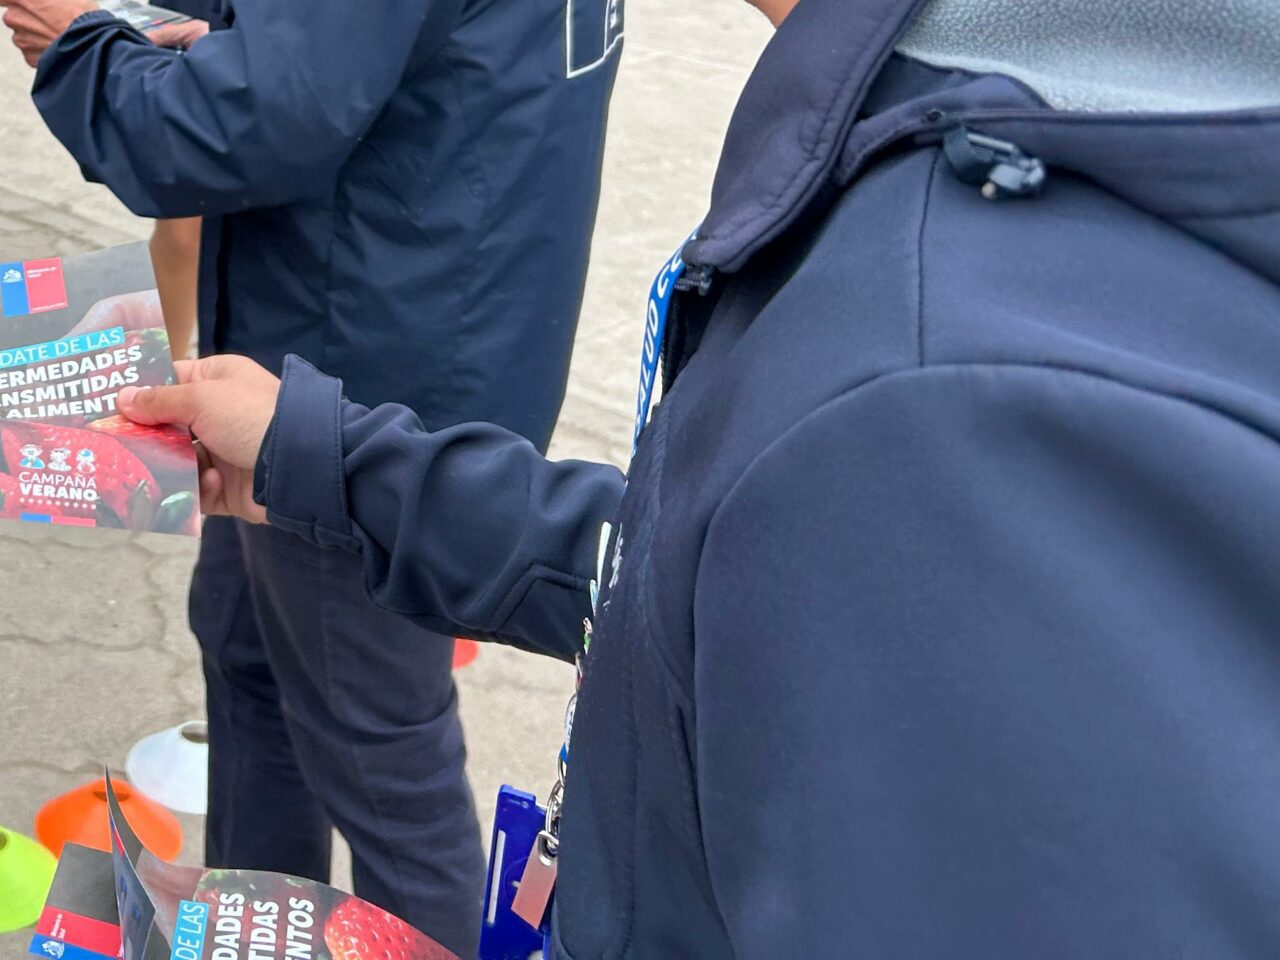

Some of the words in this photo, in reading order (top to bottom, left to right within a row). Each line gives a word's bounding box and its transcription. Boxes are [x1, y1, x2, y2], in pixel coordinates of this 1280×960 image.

[54, 341, 81, 355] DE
[87, 329, 122, 347] LAS
[19, 471, 97, 489] CAMPAÑA
[19, 483, 98, 501] VERANO
[180, 904, 206, 935] LAS
[284, 897, 315, 960] NTOS
